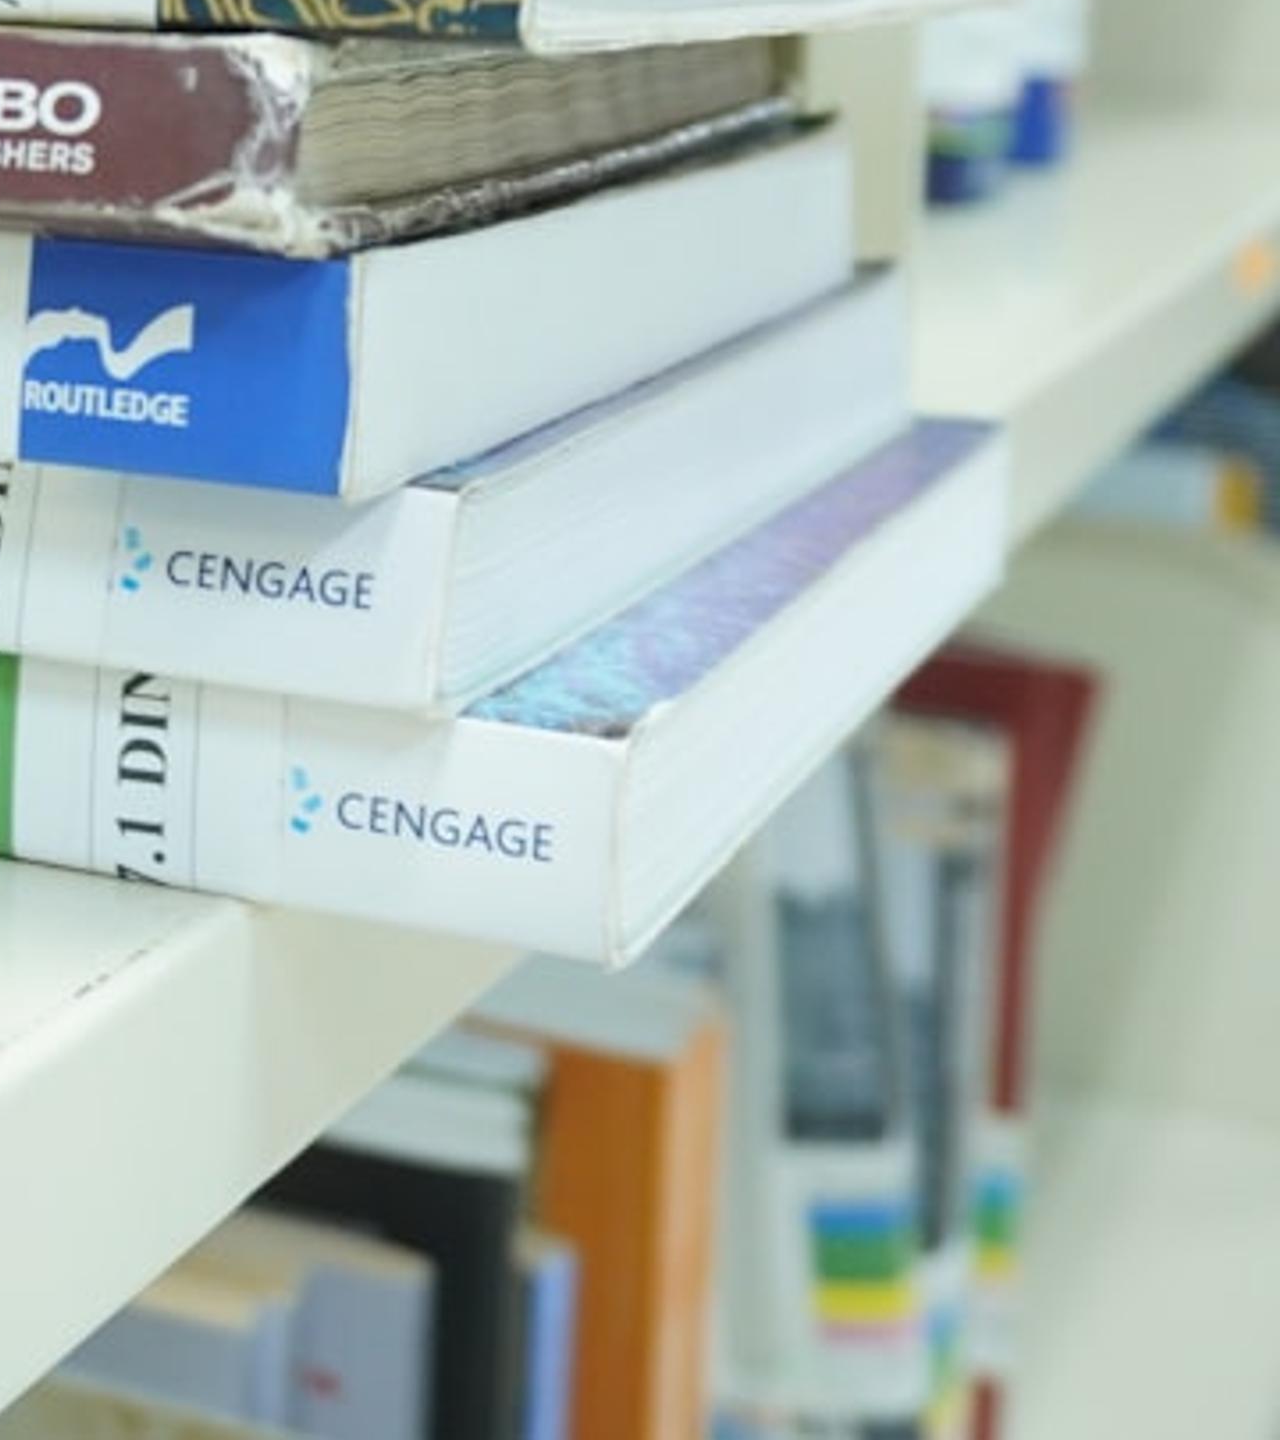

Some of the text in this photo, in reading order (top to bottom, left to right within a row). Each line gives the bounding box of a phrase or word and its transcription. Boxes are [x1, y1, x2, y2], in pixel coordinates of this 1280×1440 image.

[23, 380, 190, 426] ROUTLEDGE
[166, 550, 376, 612] CENGAGE
[337, 793, 555, 862] CENGAGE
